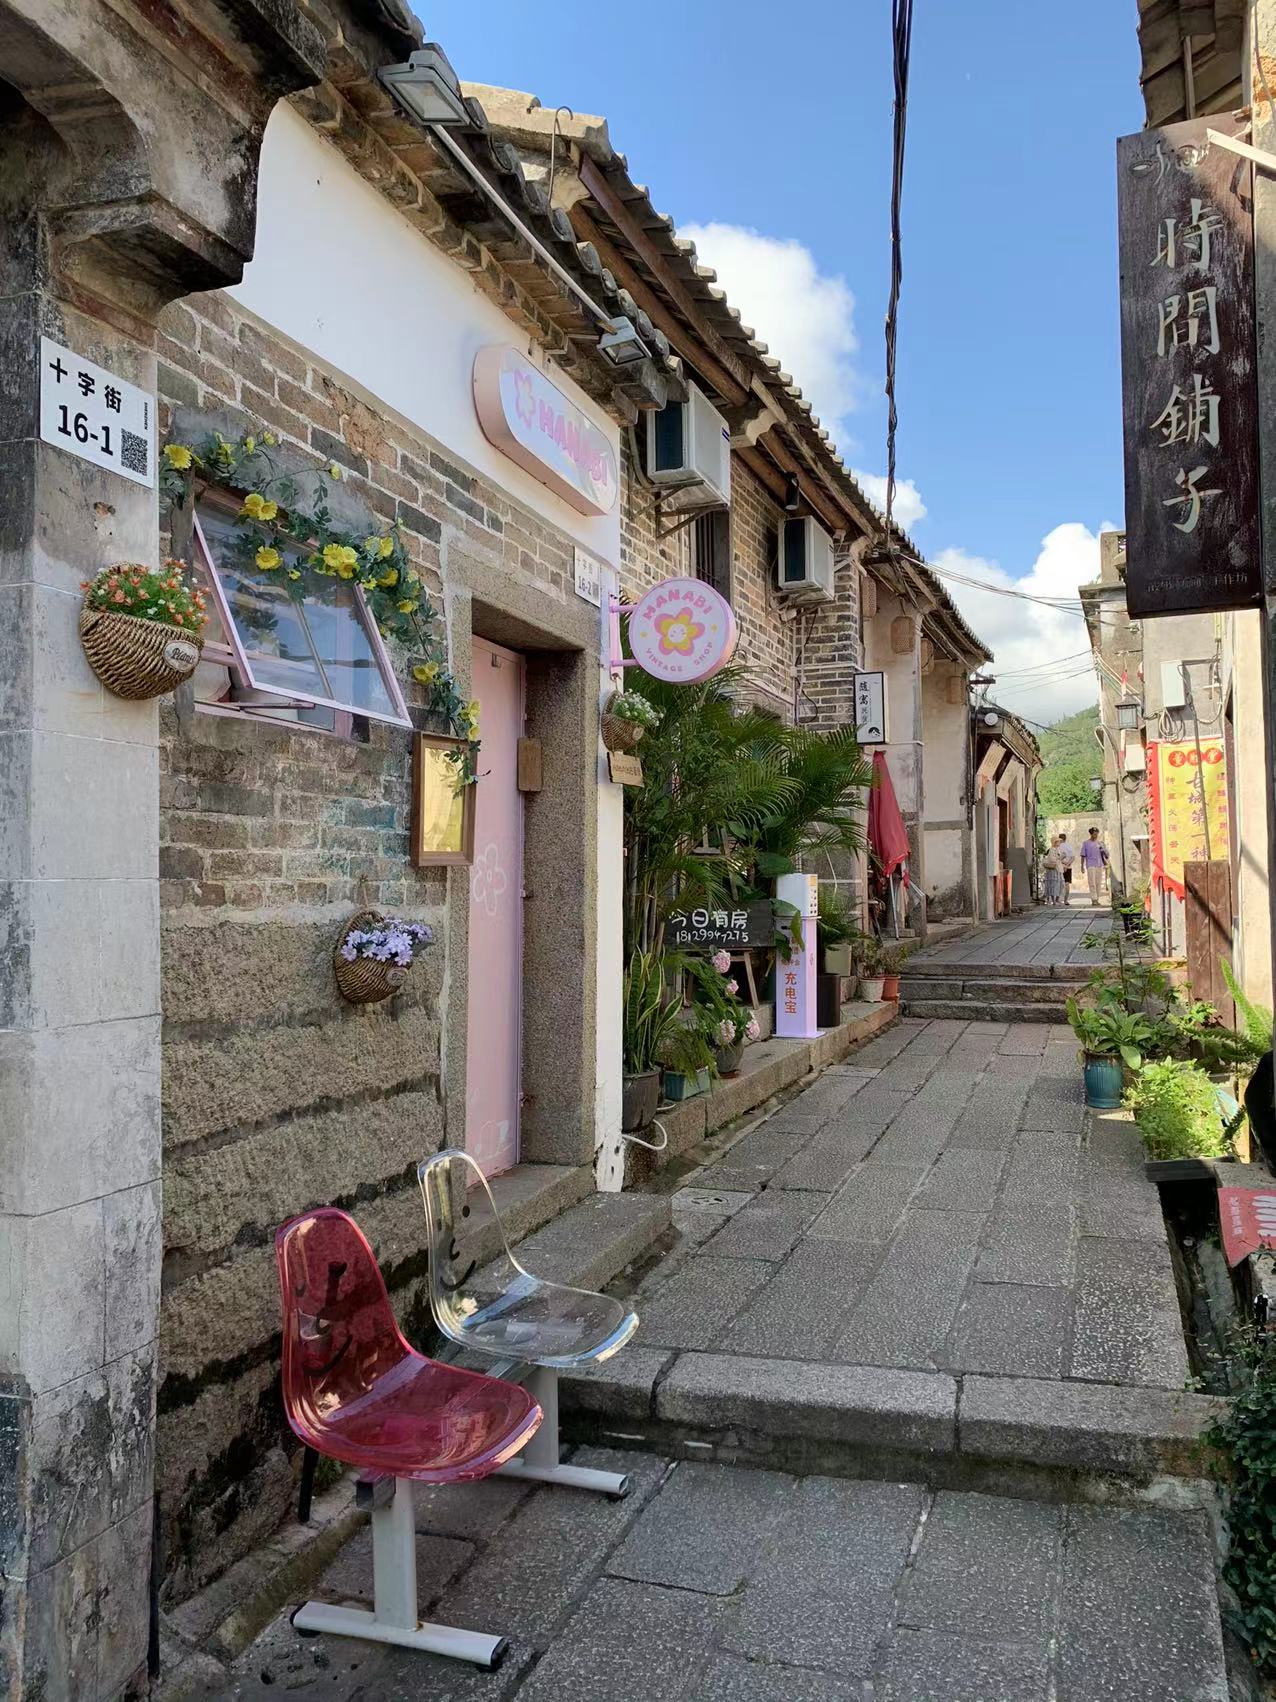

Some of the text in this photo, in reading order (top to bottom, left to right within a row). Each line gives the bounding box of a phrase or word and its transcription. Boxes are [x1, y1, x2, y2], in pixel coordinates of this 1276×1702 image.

[48, 357, 122, 414] 十字街
[57, 404, 114, 457] 16-1
[646, 641, 713, 672] VINTAGE SHOP
[784, 971, 797, 1014] 充电宝
